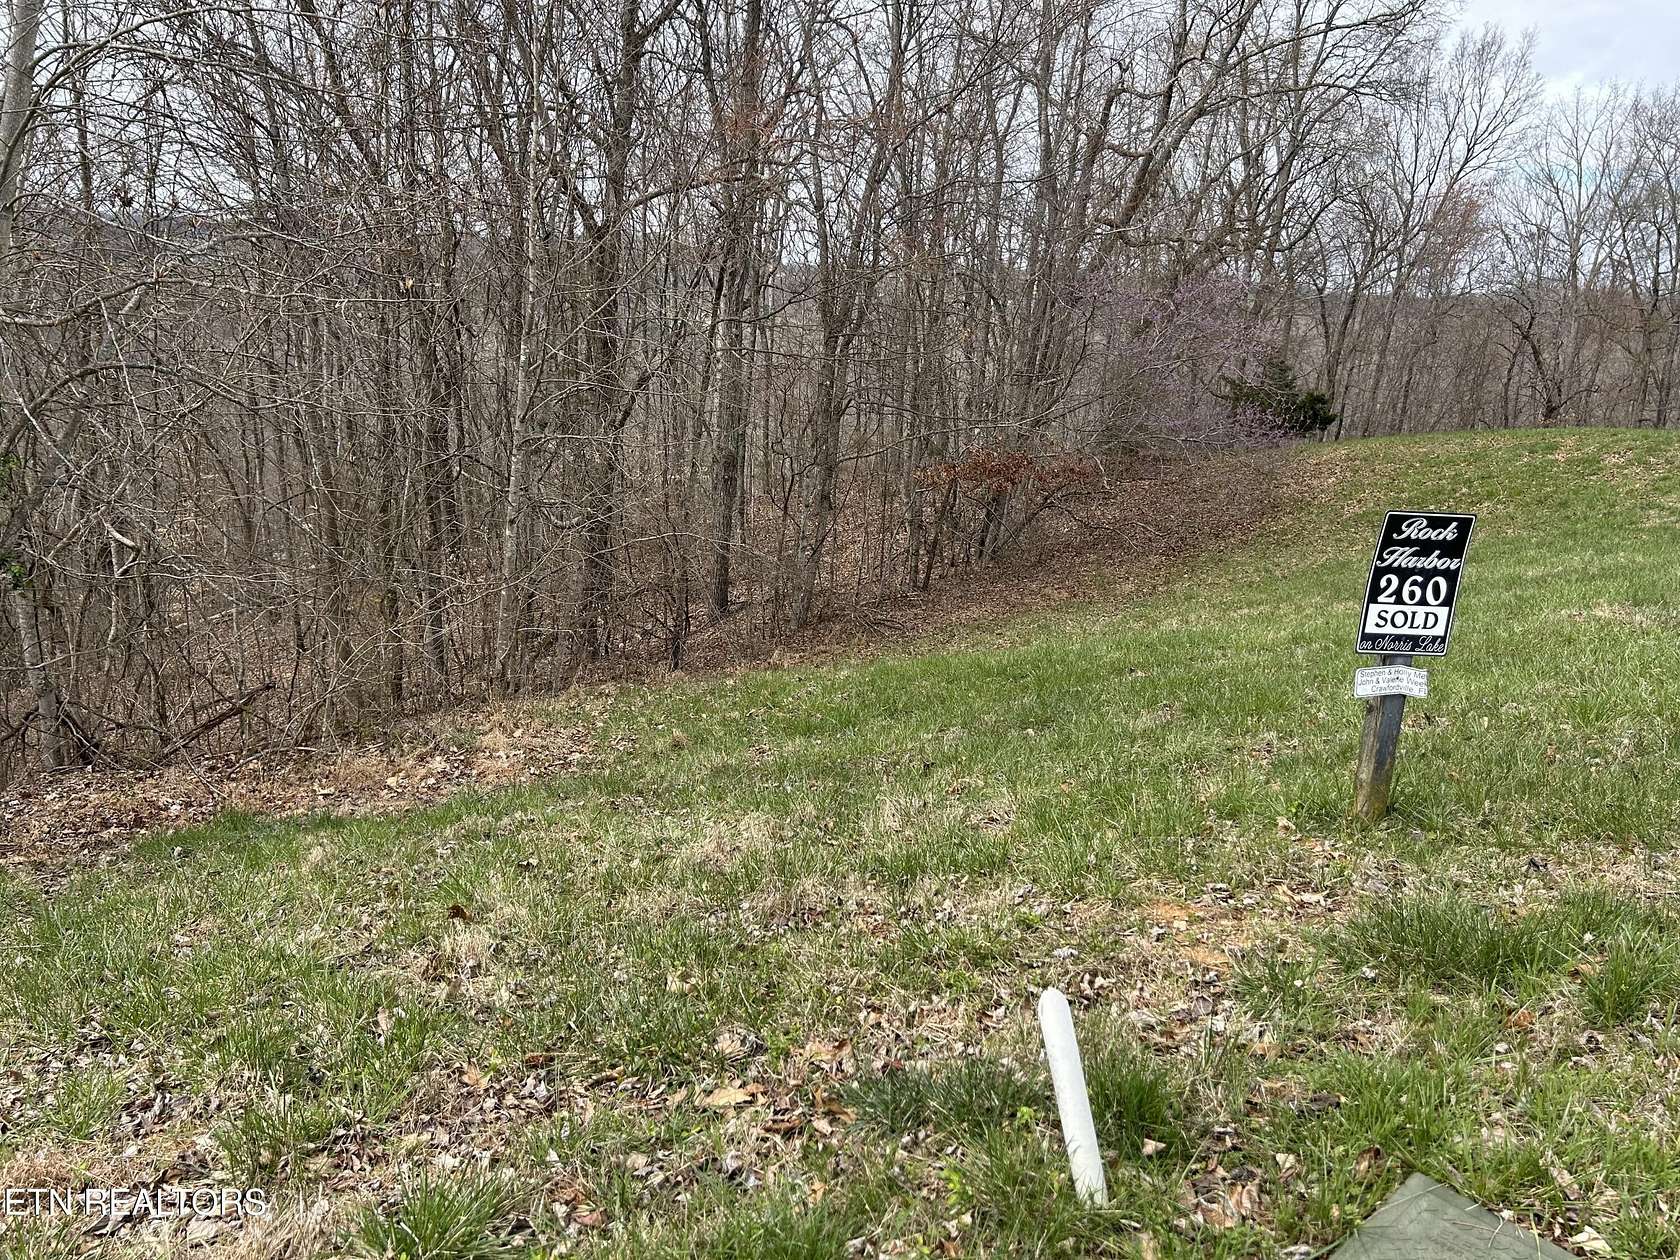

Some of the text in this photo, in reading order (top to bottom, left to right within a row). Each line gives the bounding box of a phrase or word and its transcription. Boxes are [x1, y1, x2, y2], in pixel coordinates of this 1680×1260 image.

[1393, 517, 1458, 541] Rock
[1376, 546, 1462, 570] Harbor
[1377, 573, 1447, 606] 260
[1374, 609, 1439, 630] SOLD
[1359, 634, 1445, 652] on Norris Lake
[1358, 678, 1374, 686] John
[1360, 670, 1386, 679] Stephen
